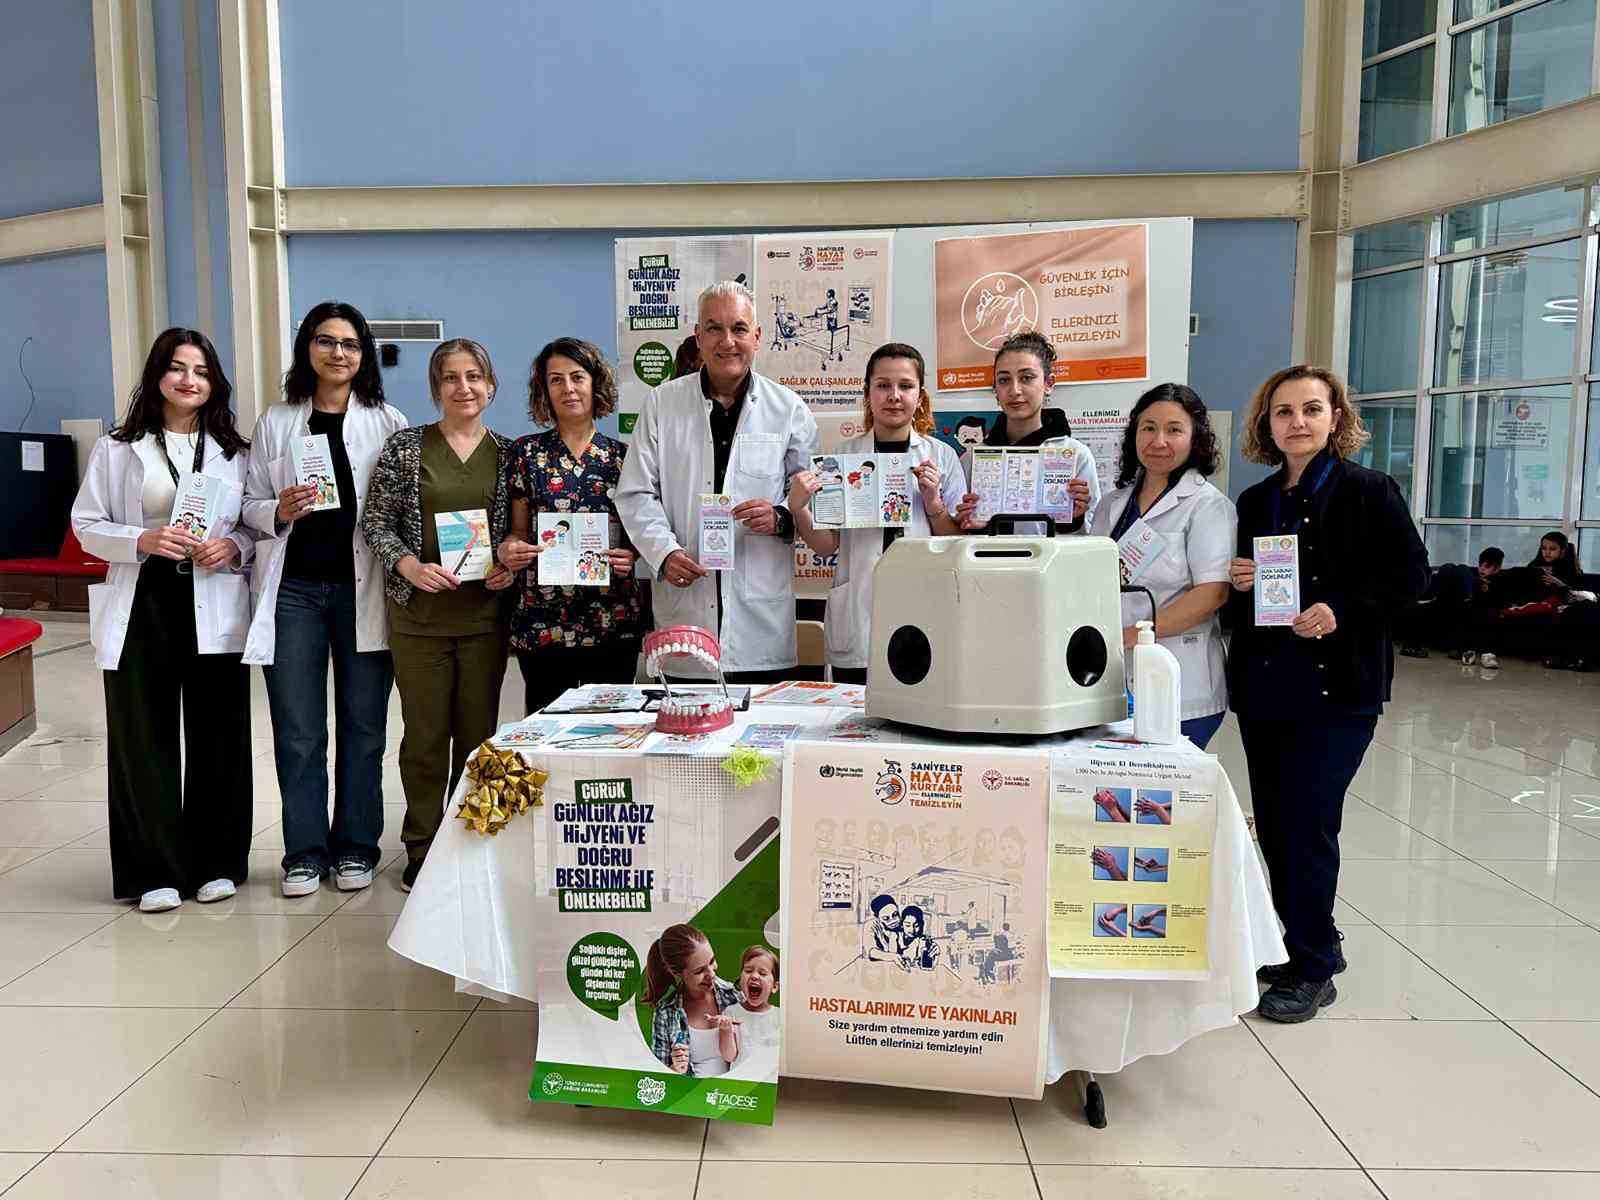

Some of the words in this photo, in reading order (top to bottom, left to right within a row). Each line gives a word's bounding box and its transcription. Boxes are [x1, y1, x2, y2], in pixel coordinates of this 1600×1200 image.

[1039, 270, 1097, 284] GÜVENLİK
[1102, 266, 1130, 280] İÇİN
[666, 281, 676, 292] VE
[628, 305, 668, 317] BESLENME
[1051, 312, 1118, 329] ELLERİNİZİ
[1049, 328, 1121, 343] TEMİZLEYİN
[779, 376, 808, 386] SAĞLIK
[1082, 409, 1120, 417] ELLERİMİZİ
[911, 761, 963, 772] SANİYELER
[910, 771, 962, 784] HAYAT
[581, 782, 626, 801] ÇÜRÜK
[910, 783, 962, 793] KURTARIR
[910, 798, 962, 809] TEMİZLEYİN
[554, 802, 616, 823] GÜNLÜK
[617, 802, 655, 823] AĞIZ
[563, 825, 624, 844] HİJYENİ
[627, 826, 646, 844] VE
[577, 845, 632, 867] DOĞRU
[556, 868, 631, 889] BESLENME
[633, 869, 654, 889] İLE
[564, 889, 646, 910] ÖNLENEBİLİR
[607, 946, 627, 957] dişler
[572, 955, 590, 966] güzel
[621, 957, 635, 969] için
[580, 968, 602, 978] günde
[603, 968, 613, 978] iki
[614, 969, 625, 979] kez
[809, 997, 915, 1018] HASTALARIMIZ
[919, 1005, 937, 1019] VE
[940, 1006, 1017, 1025] YAKINLARI
[828, 1019, 849, 1030] Size
[853, 1022, 887, 1033] yardım
[890, 1025, 940, 1037] etmemize
[942, 1029, 978, 1040] yardım
[981, 1031, 1004, 1042] edin
[845, 1034, 878, 1046] Lütfen
[880, 1038, 923, 1050] ellerinizi
[926, 1041, 983, 1055] temizleyin!
